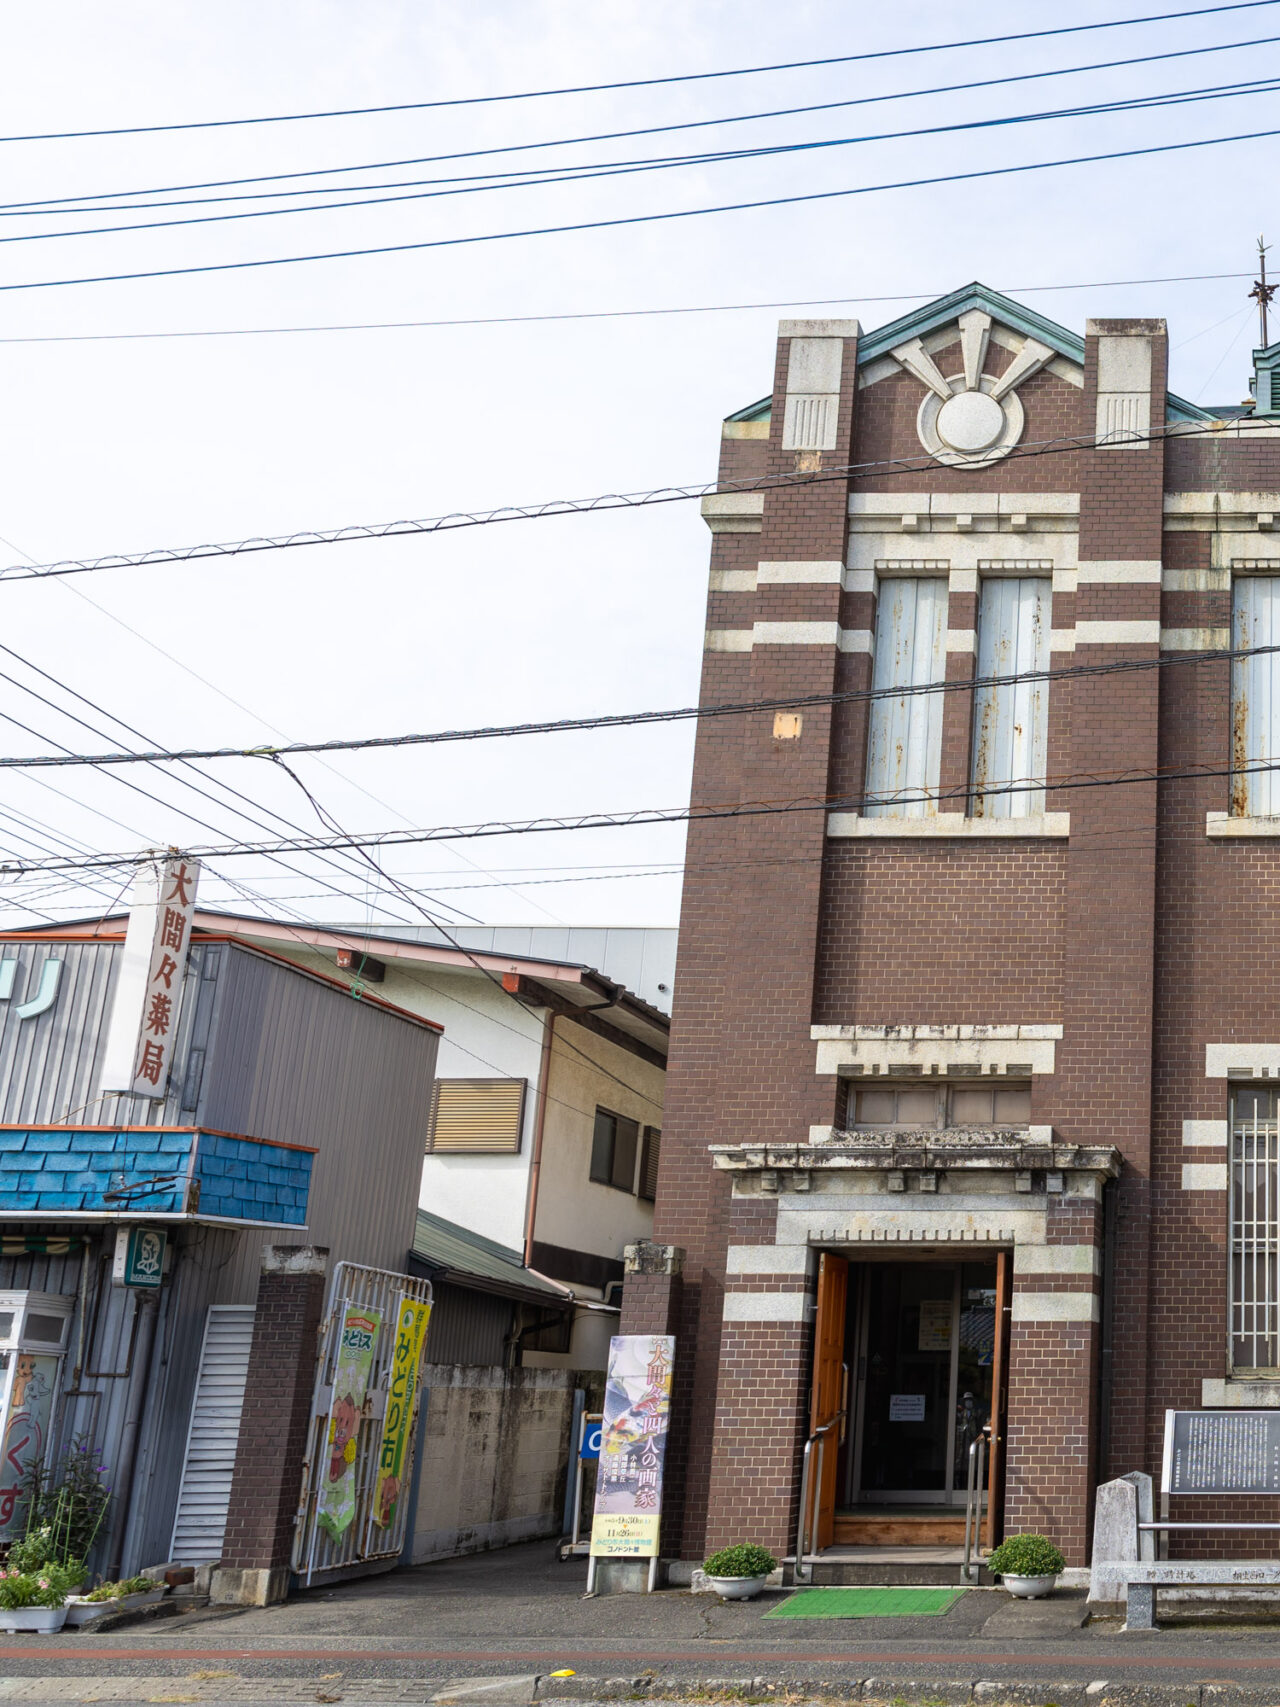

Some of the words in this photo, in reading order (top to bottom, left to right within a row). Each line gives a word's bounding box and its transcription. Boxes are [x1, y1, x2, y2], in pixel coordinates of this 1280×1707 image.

[135, 862, 195, 1087] 大間々薬局
[380, 1332, 411, 1469] みどり市
[635, 1344, 669, 1509] 大間々と四人の画家
